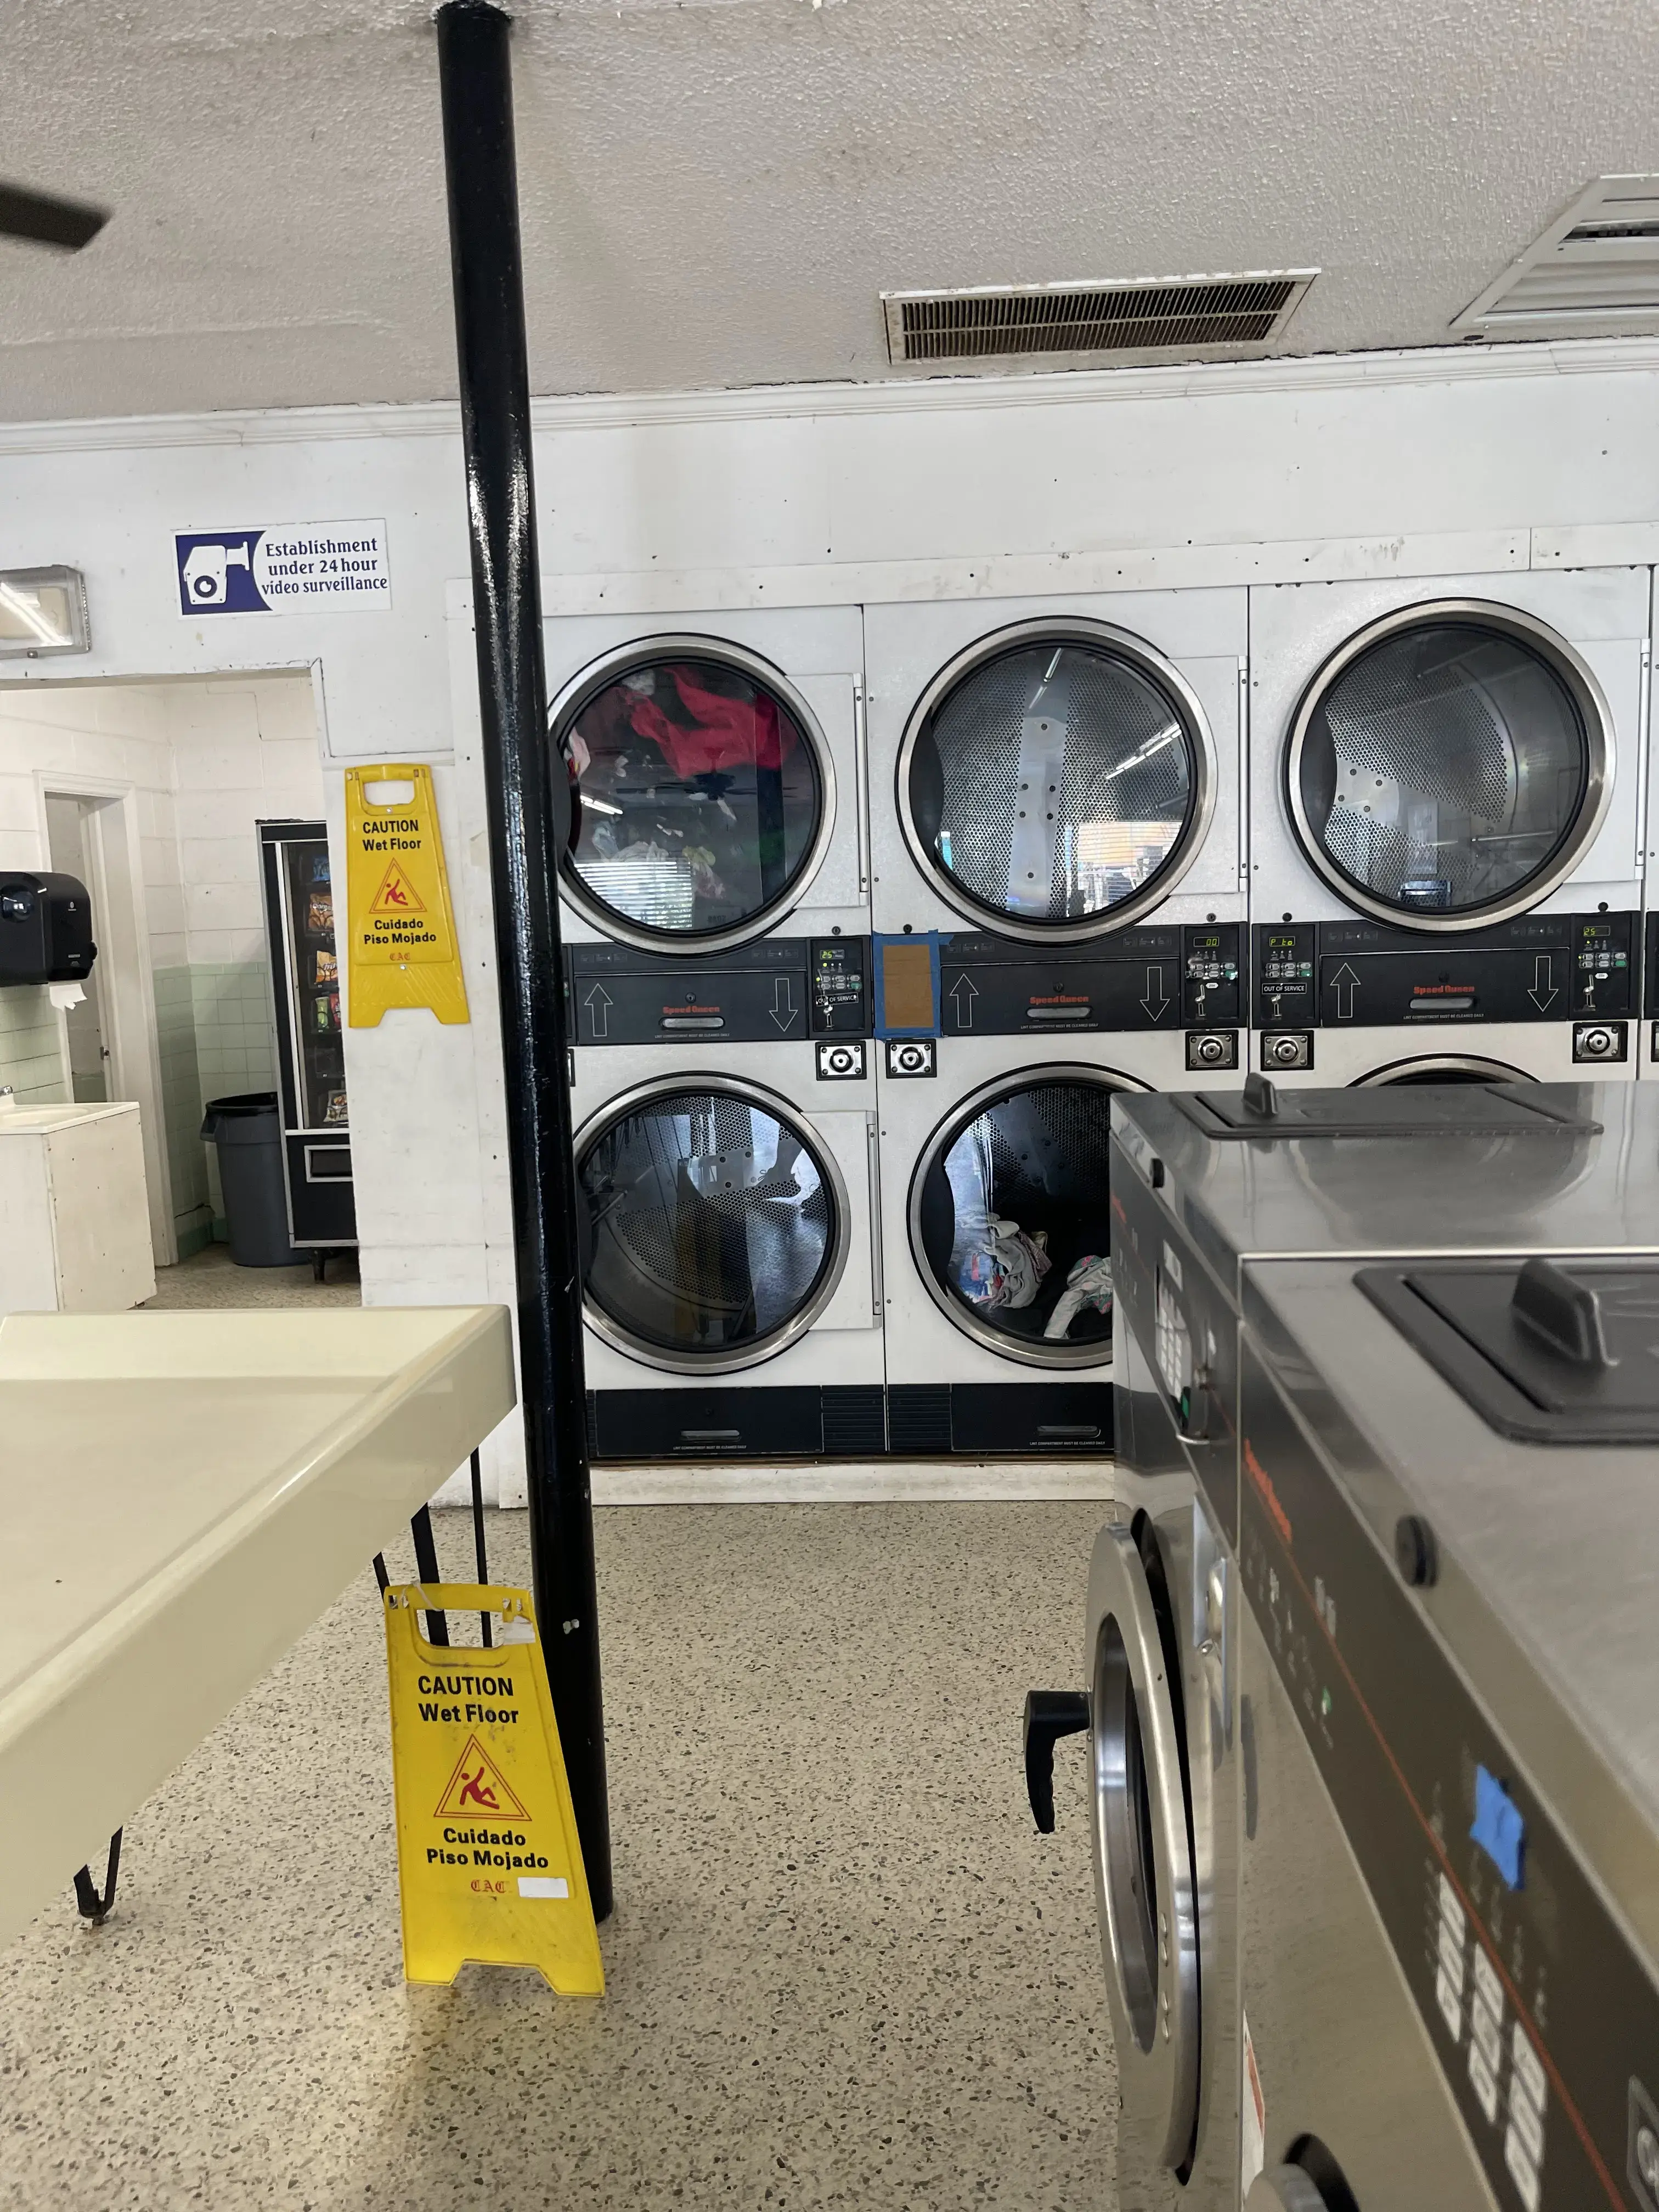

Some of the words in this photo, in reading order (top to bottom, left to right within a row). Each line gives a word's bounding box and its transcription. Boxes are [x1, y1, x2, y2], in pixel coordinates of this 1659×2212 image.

[266, 538, 378, 557] Establishment
[268, 562, 314, 576] under
[319, 560, 338, 573] 24
[341, 558, 377, 572] hour
[261, 580, 299, 595] video
[303, 577, 388, 593] surveillance
[363, 819, 419, 834] CAUTION
[363, 839, 387, 851] Wet
[390, 838, 421, 850] Floor
[374, 918, 423, 930] Cuidado
[364, 934, 389, 944] Piso
[392, 933, 436, 944] Mojado
[390, 952, 410, 961] CAC
[1414, 985, 1444, 995] Speed
[1030, 996, 1059, 1005] Speed
[663, 1005, 691, 1015] Speed
[418, 1676, 514, 1696] CAUTION
[418, 1703, 461, 1722] Wet
[466, 1704, 518, 1723] Floor
[443, 1828, 526, 1846] Cuidado
[427, 1848, 468, 1865] Piso
[473, 1850, 549, 1870] Mojado
[471, 1880, 505, 1893] CAC
